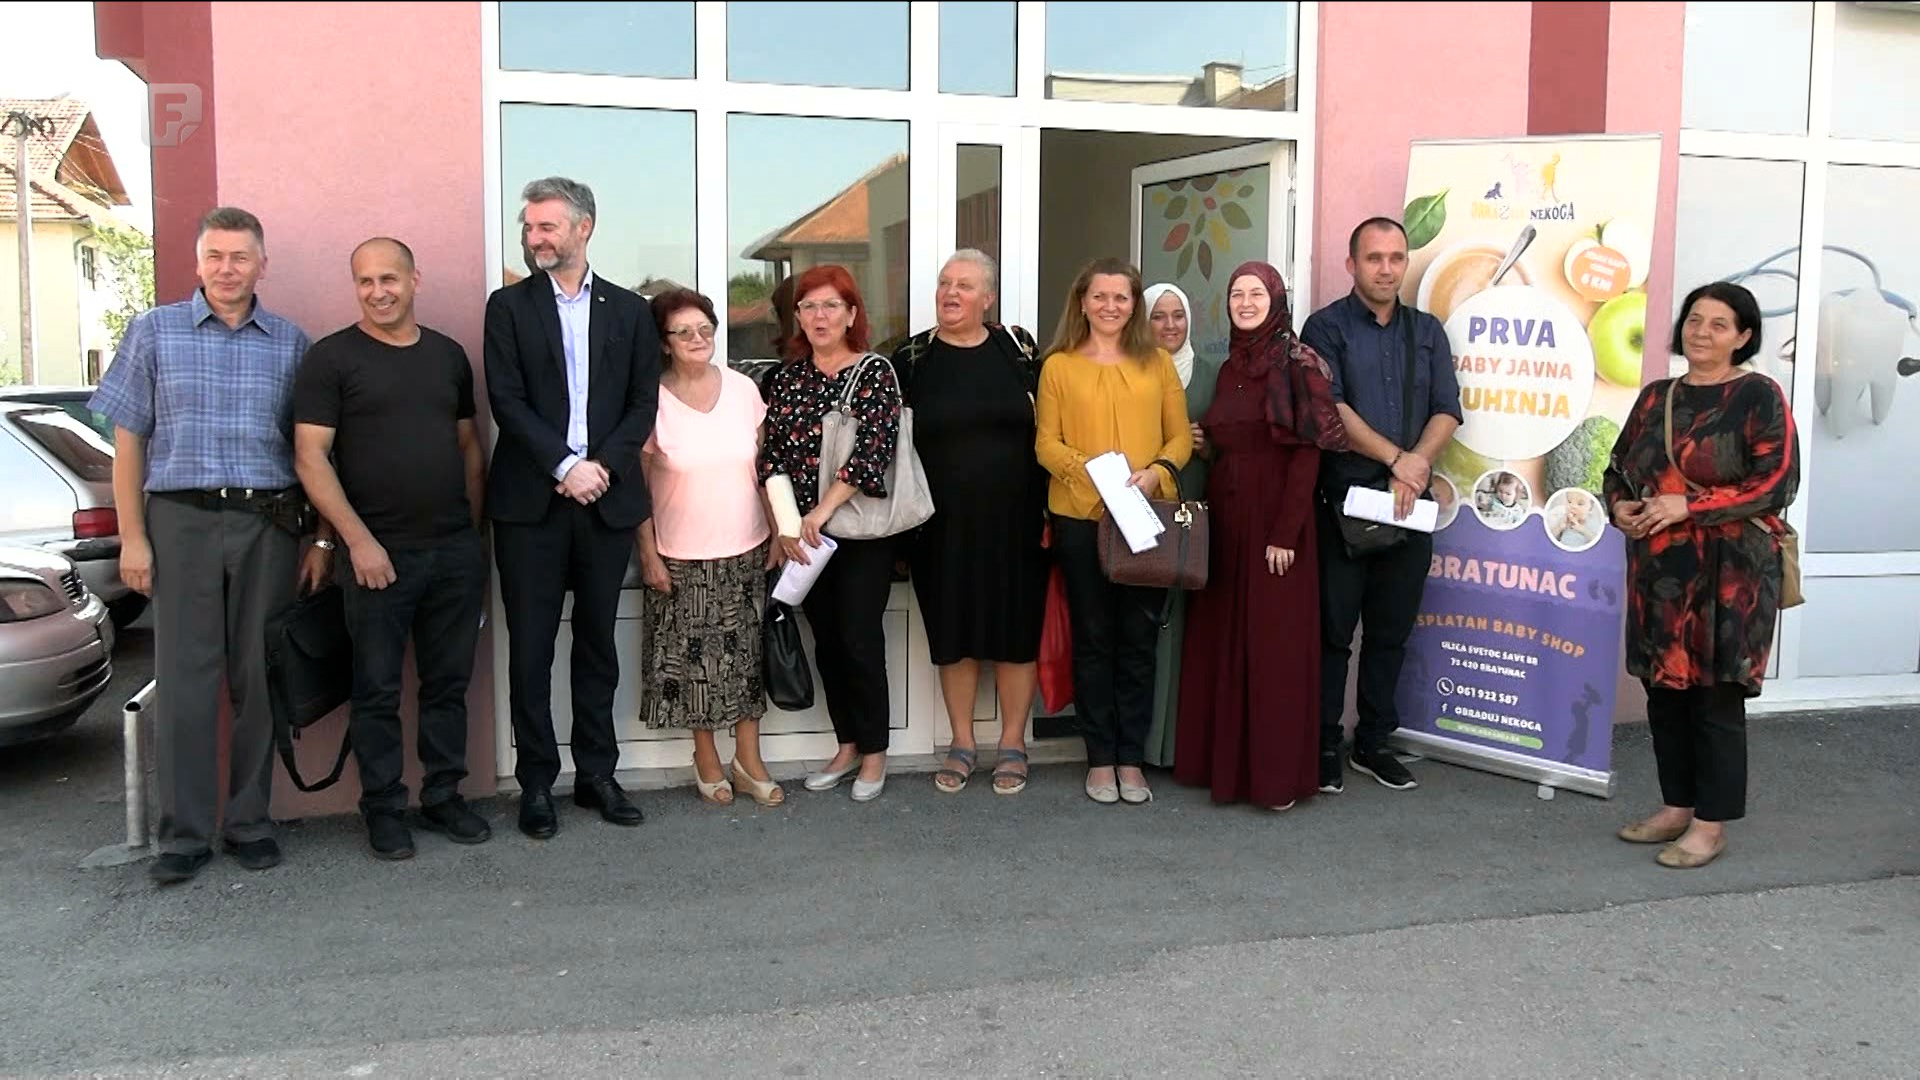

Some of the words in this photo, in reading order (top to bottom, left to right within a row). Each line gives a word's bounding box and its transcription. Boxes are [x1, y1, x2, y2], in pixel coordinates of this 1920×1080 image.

[1530, 202, 1575, 220] NEKOGA
[1468, 316, 1556, 348] PRVA
[1451, 354, 1501, 374] BABY
[1506, 359, 1573, 380] JAVNA
[1462, 386, 1571, 419] UHINJA
[1428, 553, 1577, 600] BRATUNAC
[1416, 613, 1488, 630] SPLATAN
[1492, 619, 1537, 640] BABY
[1541, 632, 1585, 658] SHOP
[1480, 663, 1526, 680] BRATUNAC
[1456, 685, 1476, 698] 061
[1477, 689, 1497, 702] 922
[1498, 693, 1519, 706] 587
[1454, 706, 1499, 723] OBRADUJ
